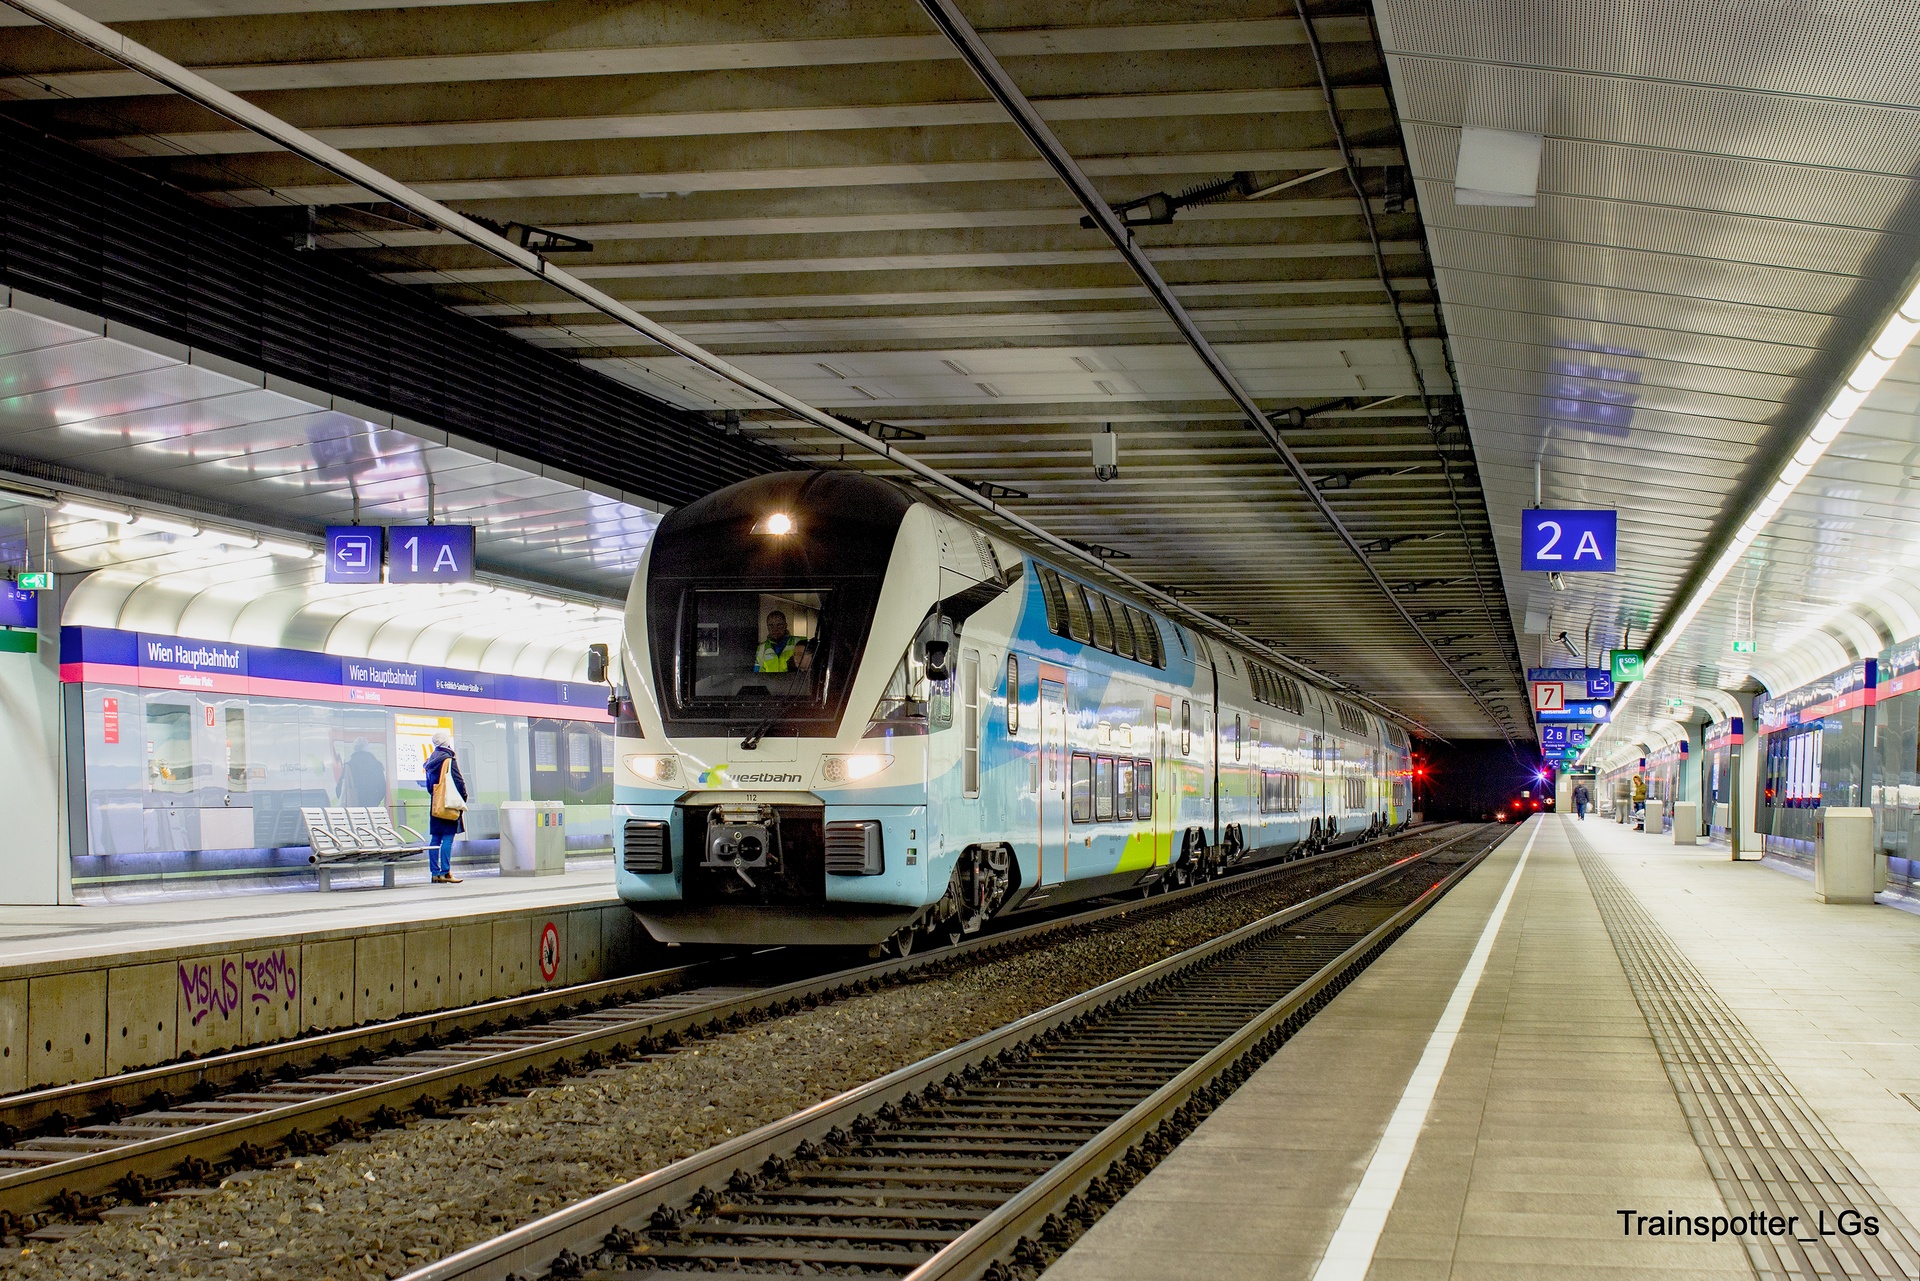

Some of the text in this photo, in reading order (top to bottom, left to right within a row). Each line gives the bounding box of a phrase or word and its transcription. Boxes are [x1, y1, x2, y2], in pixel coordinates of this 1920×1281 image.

[1536, 520, 1603, 560] 2 A
[404, 536, 459, 573] 1 A
[148, 643, 239, 669] Wien Hauptbahnhof
[349, 664, 368, 681] Wien
[369, 666, 417, 687] Hauptbahnhof
[1544, 688, 1555, 705] 7
[1546, 729, 1563, 740] 2 B
[728, 773, 802, 783] westbahn
[746, 794, 757, 802] 112
